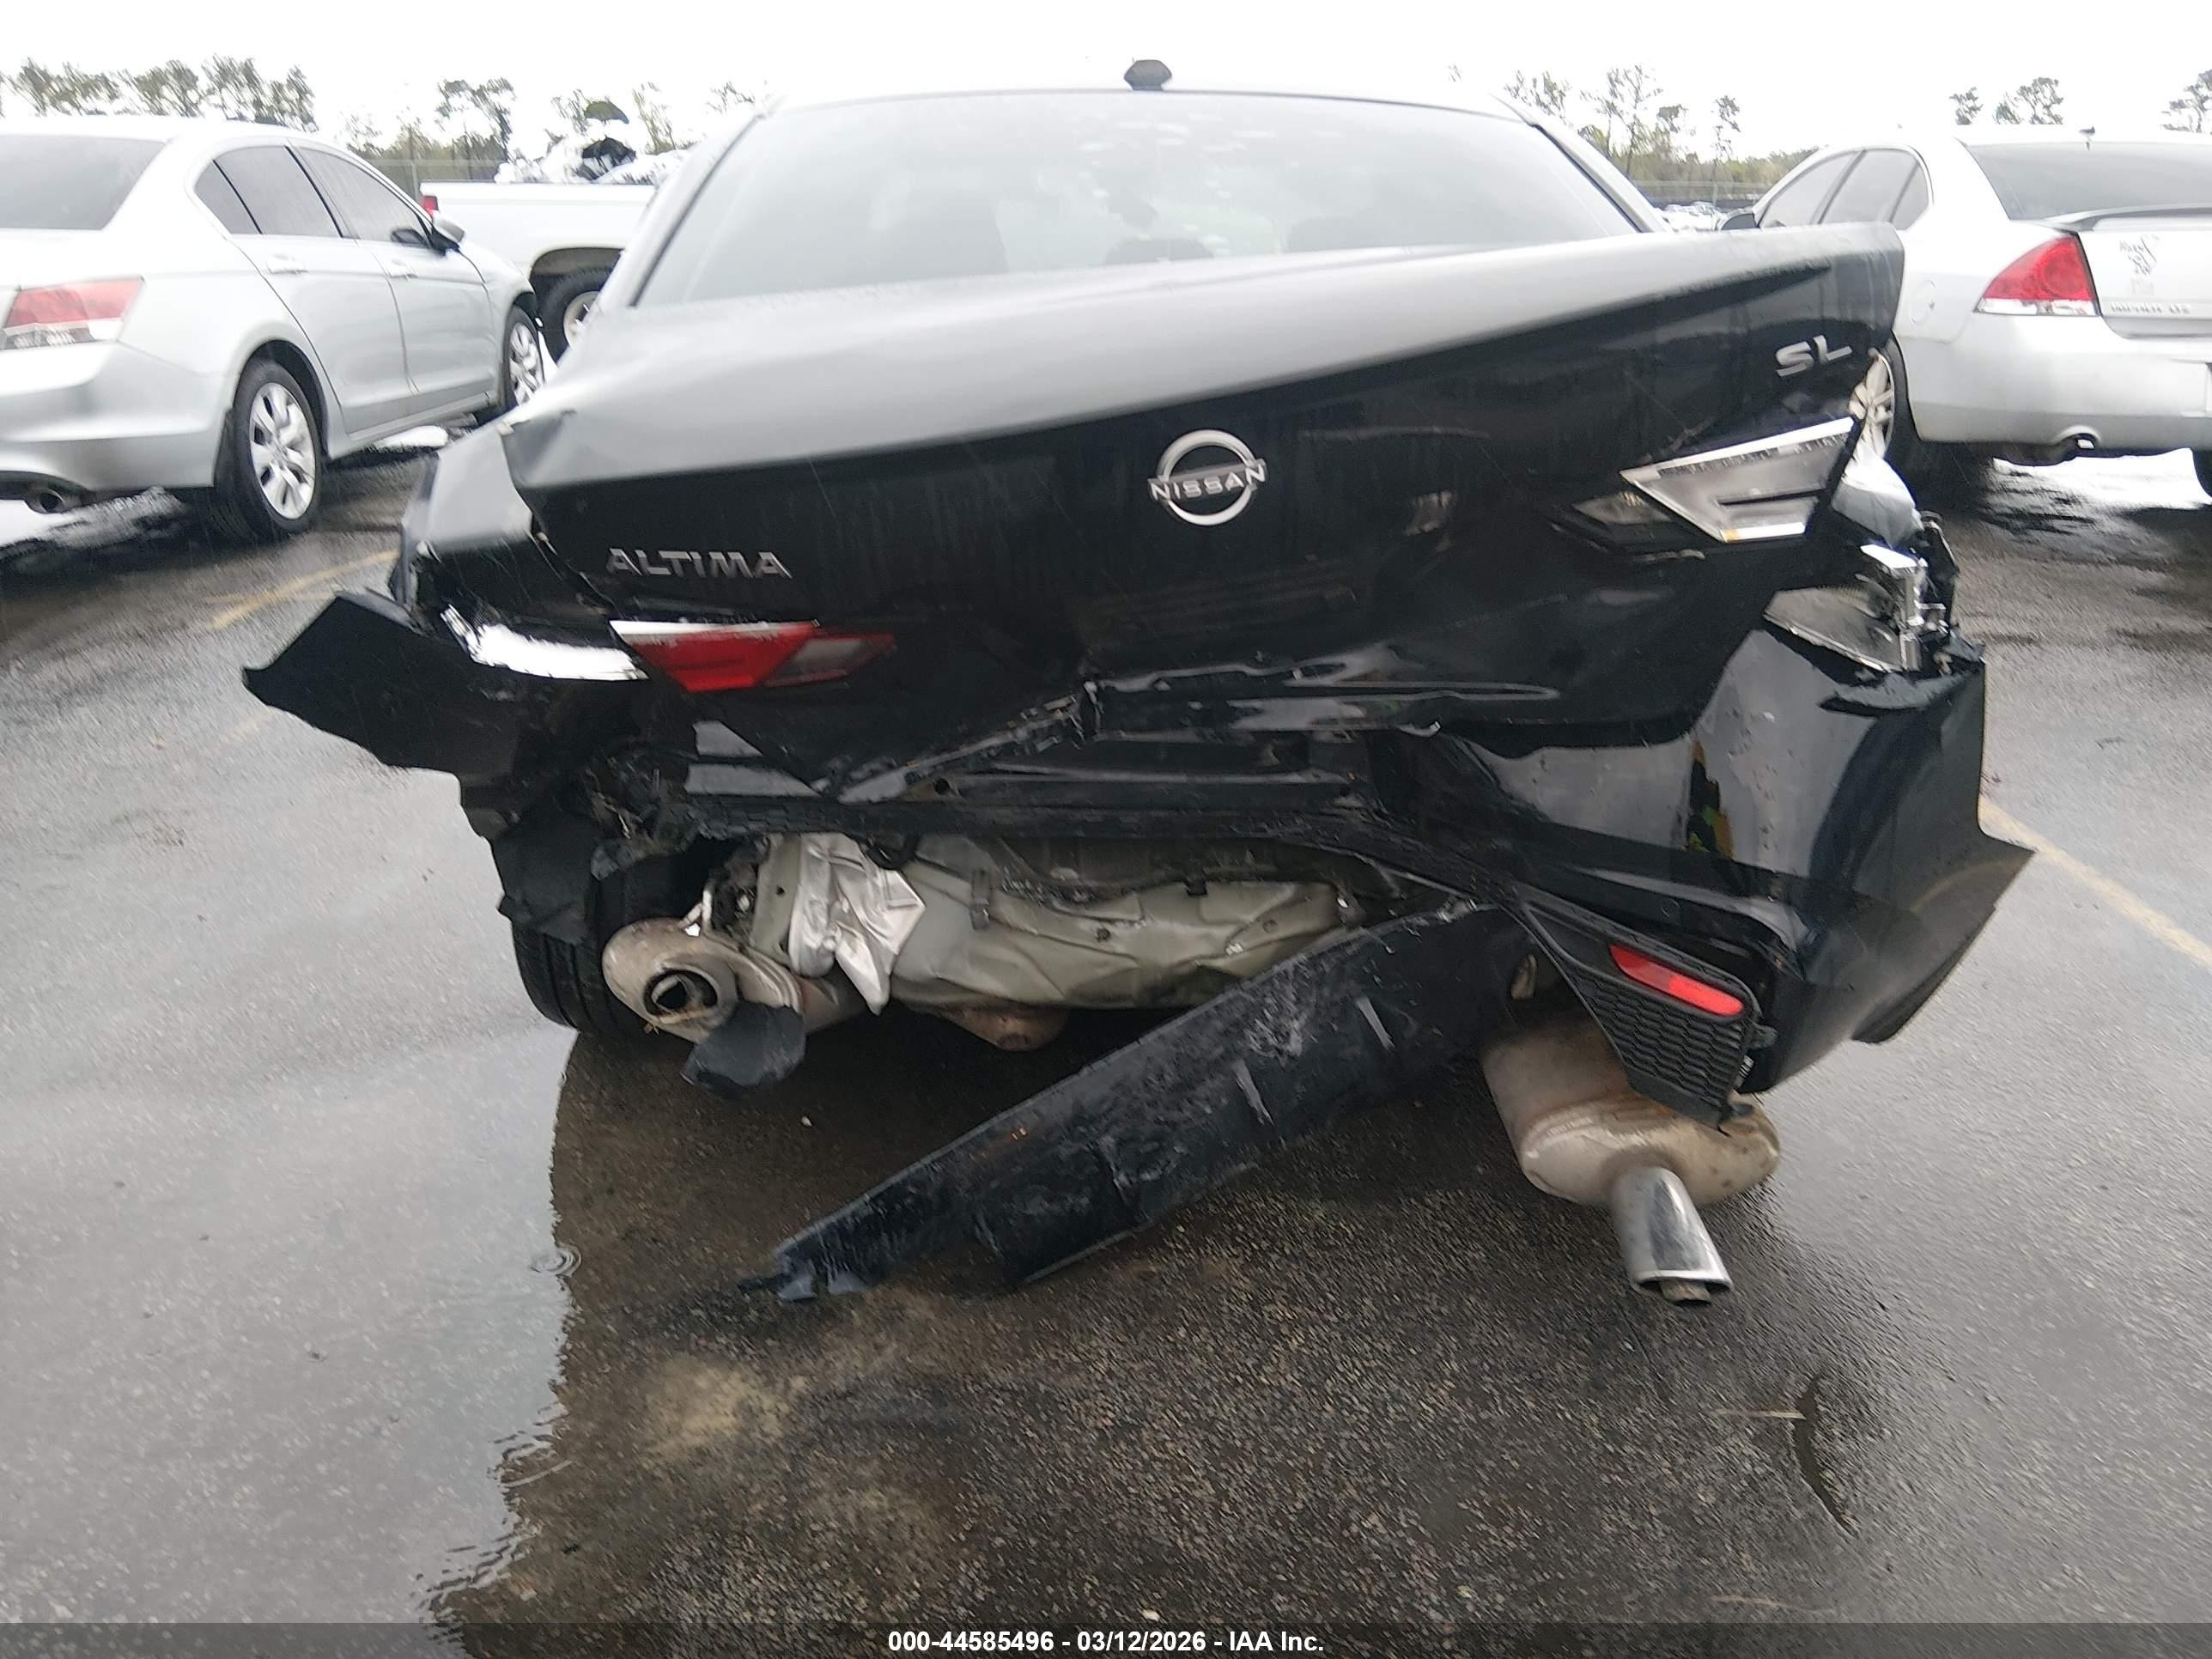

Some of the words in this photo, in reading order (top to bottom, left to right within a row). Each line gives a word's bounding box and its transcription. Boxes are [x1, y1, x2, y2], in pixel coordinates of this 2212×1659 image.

[1775, 334, 1853, 377] SL
[1150, 464, 1266, 501] NISSAN
[605, 547, 793, 578] ALTIMA
